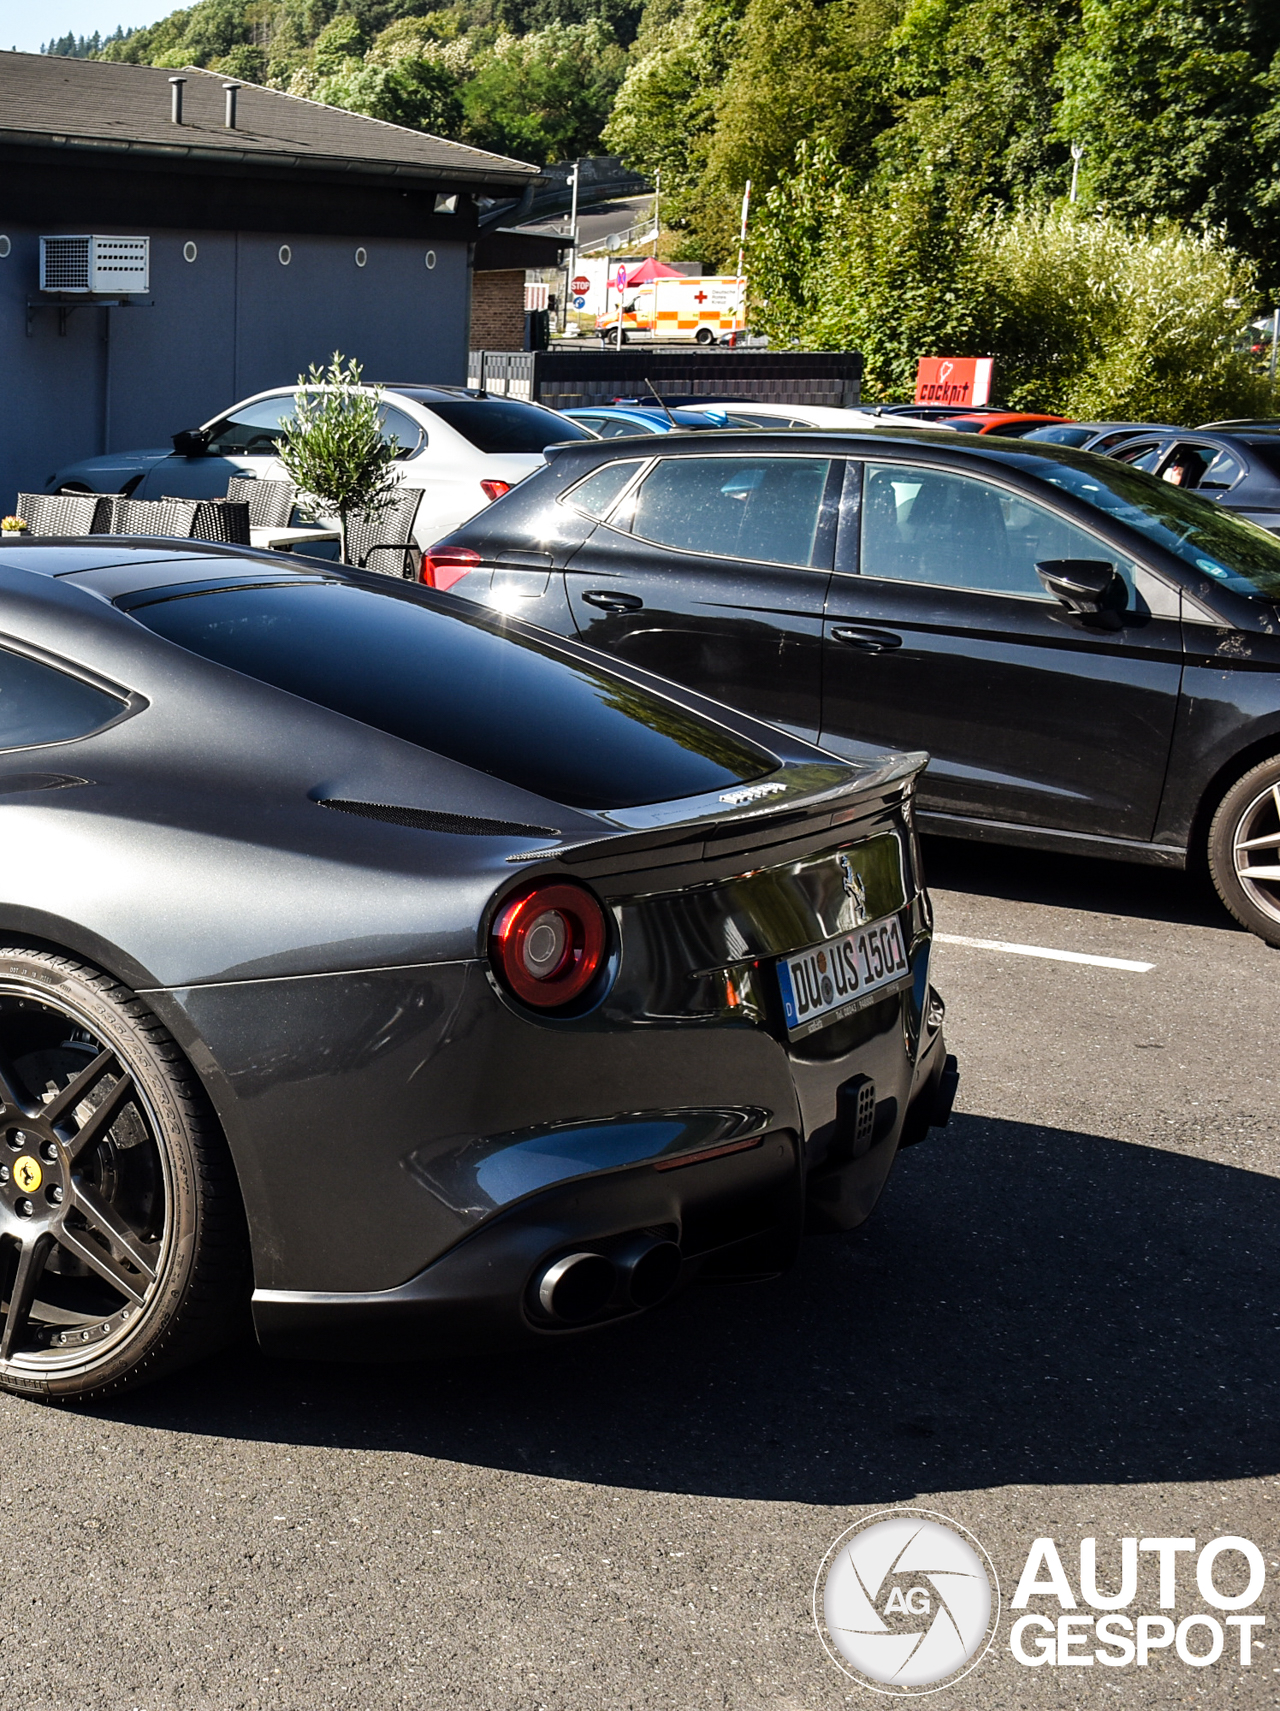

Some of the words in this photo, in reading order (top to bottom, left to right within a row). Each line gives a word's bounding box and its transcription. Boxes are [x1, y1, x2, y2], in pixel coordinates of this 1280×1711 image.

[571, 281, 590, 290] STOP
[920, 382, 969, 405] cockpit
[791, 955, 823, 1016] DU
[829, 939, 859, 996] US
[858, 922, 906, 985] 1501
[786, 1002, 793, 1017] D
